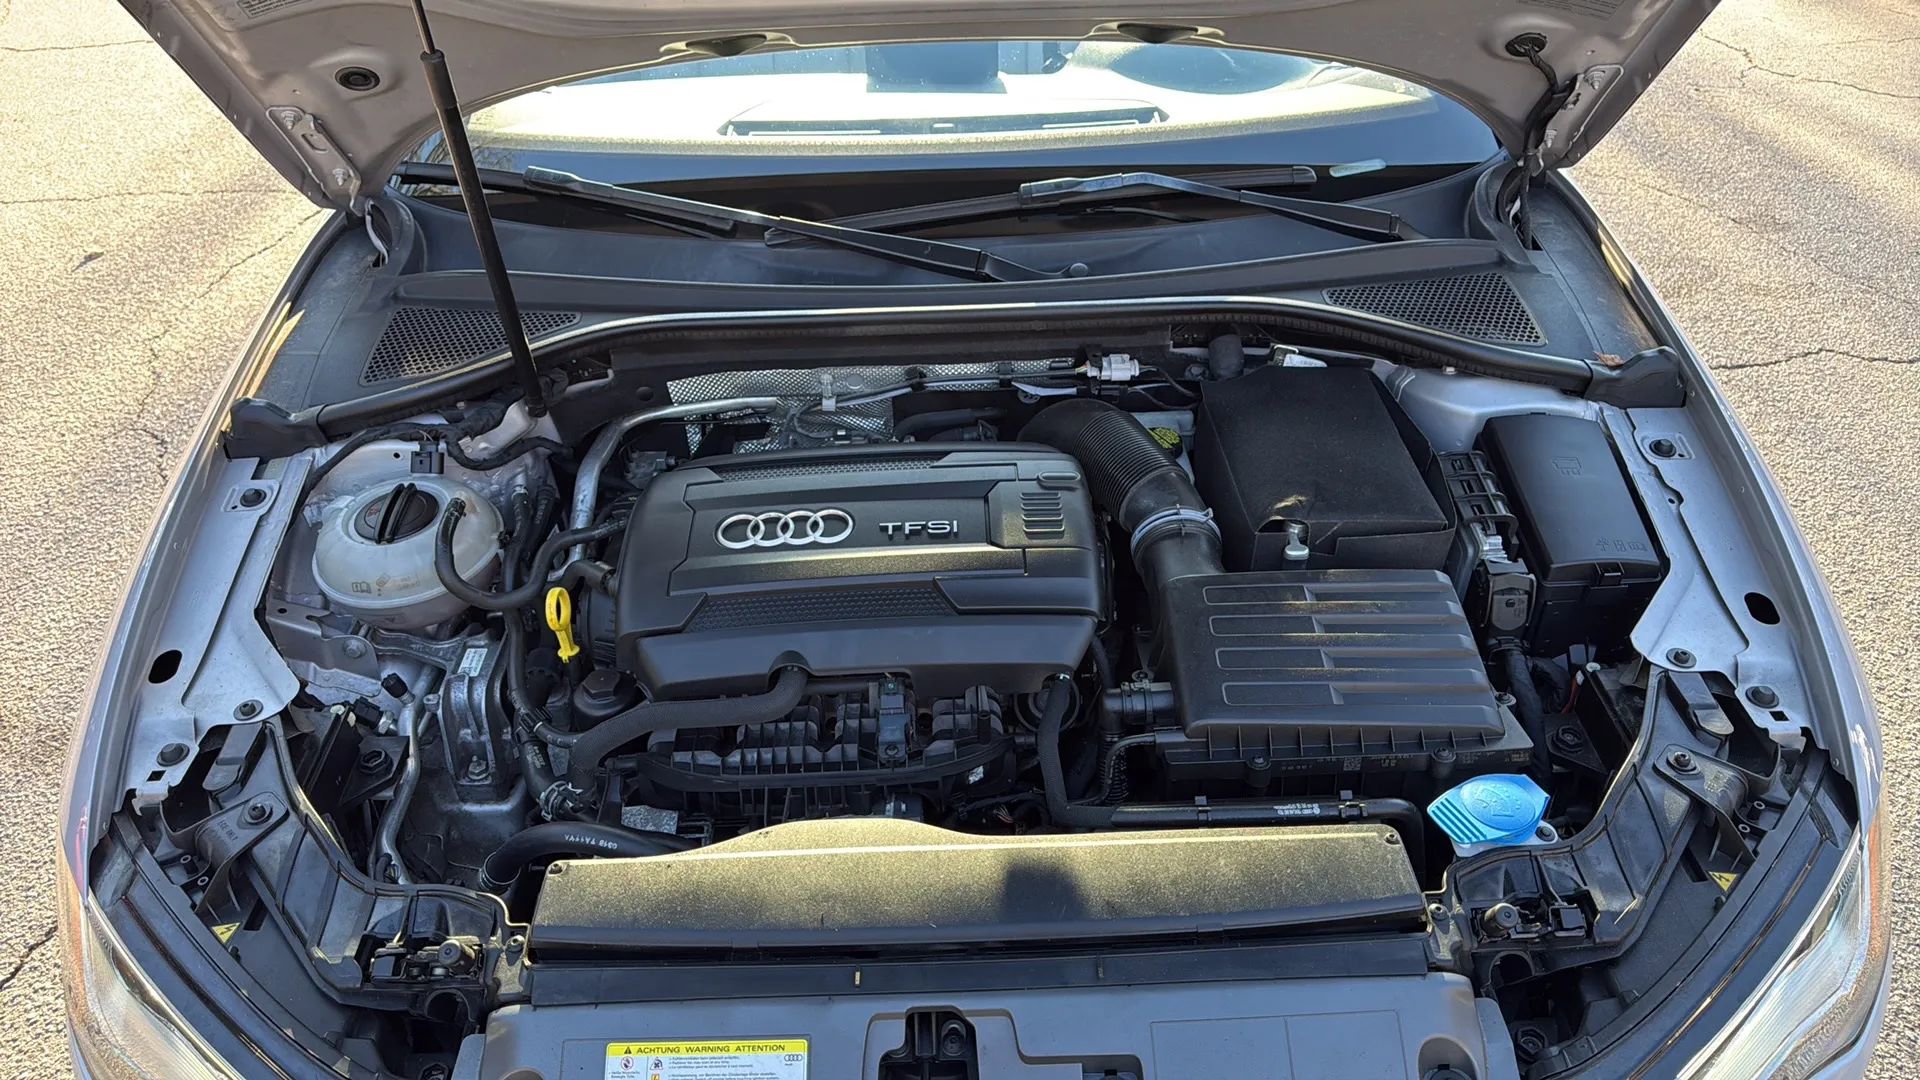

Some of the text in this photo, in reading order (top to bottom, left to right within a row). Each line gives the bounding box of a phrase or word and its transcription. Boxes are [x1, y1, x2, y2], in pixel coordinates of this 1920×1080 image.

[879, 520, 958, 535] TFSI
[636, 1044, 785, 1054] ACHTUNG WARNING ATTENTION
